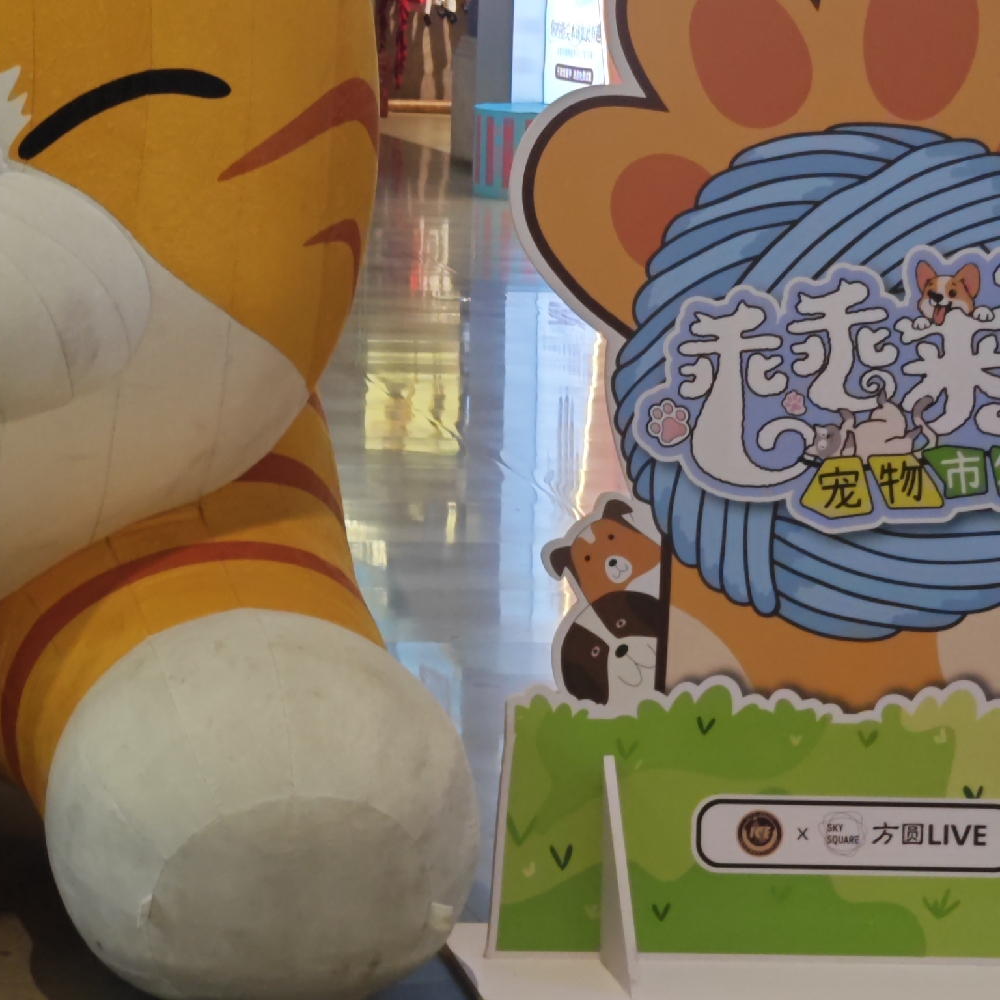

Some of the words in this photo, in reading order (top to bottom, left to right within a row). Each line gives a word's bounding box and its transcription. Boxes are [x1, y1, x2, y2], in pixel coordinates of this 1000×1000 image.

[818, 452, 1000, 510] 宠物市
[827, 823, 843, 833] SKY
[827, 834, 860, 846] SQUARE
